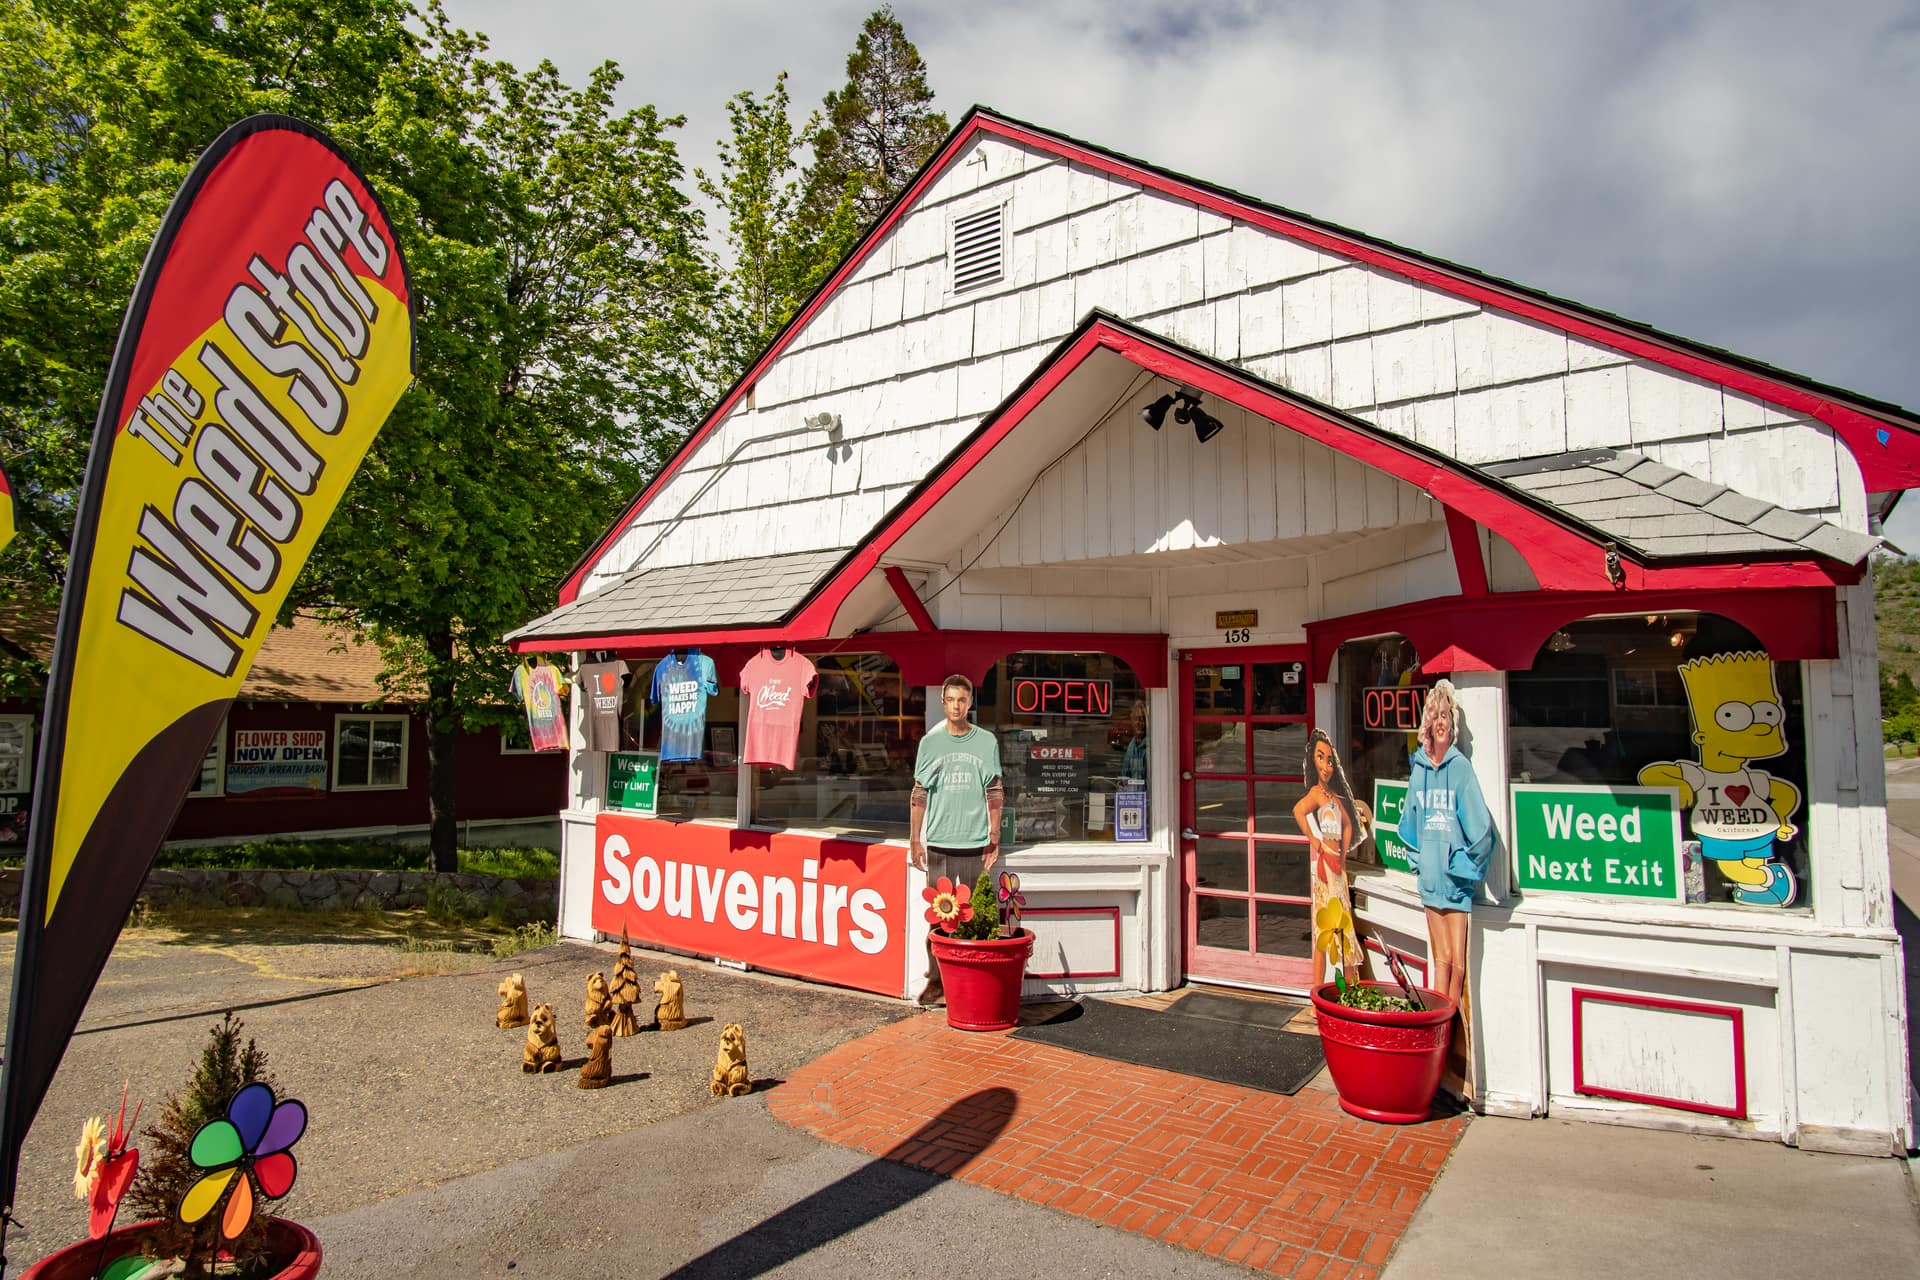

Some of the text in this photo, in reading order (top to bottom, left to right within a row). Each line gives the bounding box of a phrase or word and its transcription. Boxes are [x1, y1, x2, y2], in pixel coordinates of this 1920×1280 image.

[128, 367, 206, 467] The
[116, 178, 390, 678] Weed Store
[1225, 628, 1250, 643] 158
[593, 675, 602, 695] I
[669, 680, 699, 694] WEED
[669, 692, 698, 702] MAKES ME
[757, 685, 792, 708] Weed
[1016, 680, 1109, 714] OPEN
[669, 701, 698, 715] HAPPY
[1365, 689, 1427, 727] OPEN
[237, 732, 324, 748] FLOWER SHOP
[237, 747, 323, 762] NOW OPEN
[1040, 748, 1072, 759] OPEN
[228, 764, 267, 776] DAWSON
[617, 758, 649, 772] Weed
[612, 780, 651, 792] CITY LIMIT
[1707, 786, 1720, 806] I
[1541, 803, 1642, 843] Weed
[1700, 808, 1768, 825] WEED
[1528, 854, 1664, 887] Next Exit
[601, 833, 888, 955] Souvenirs
